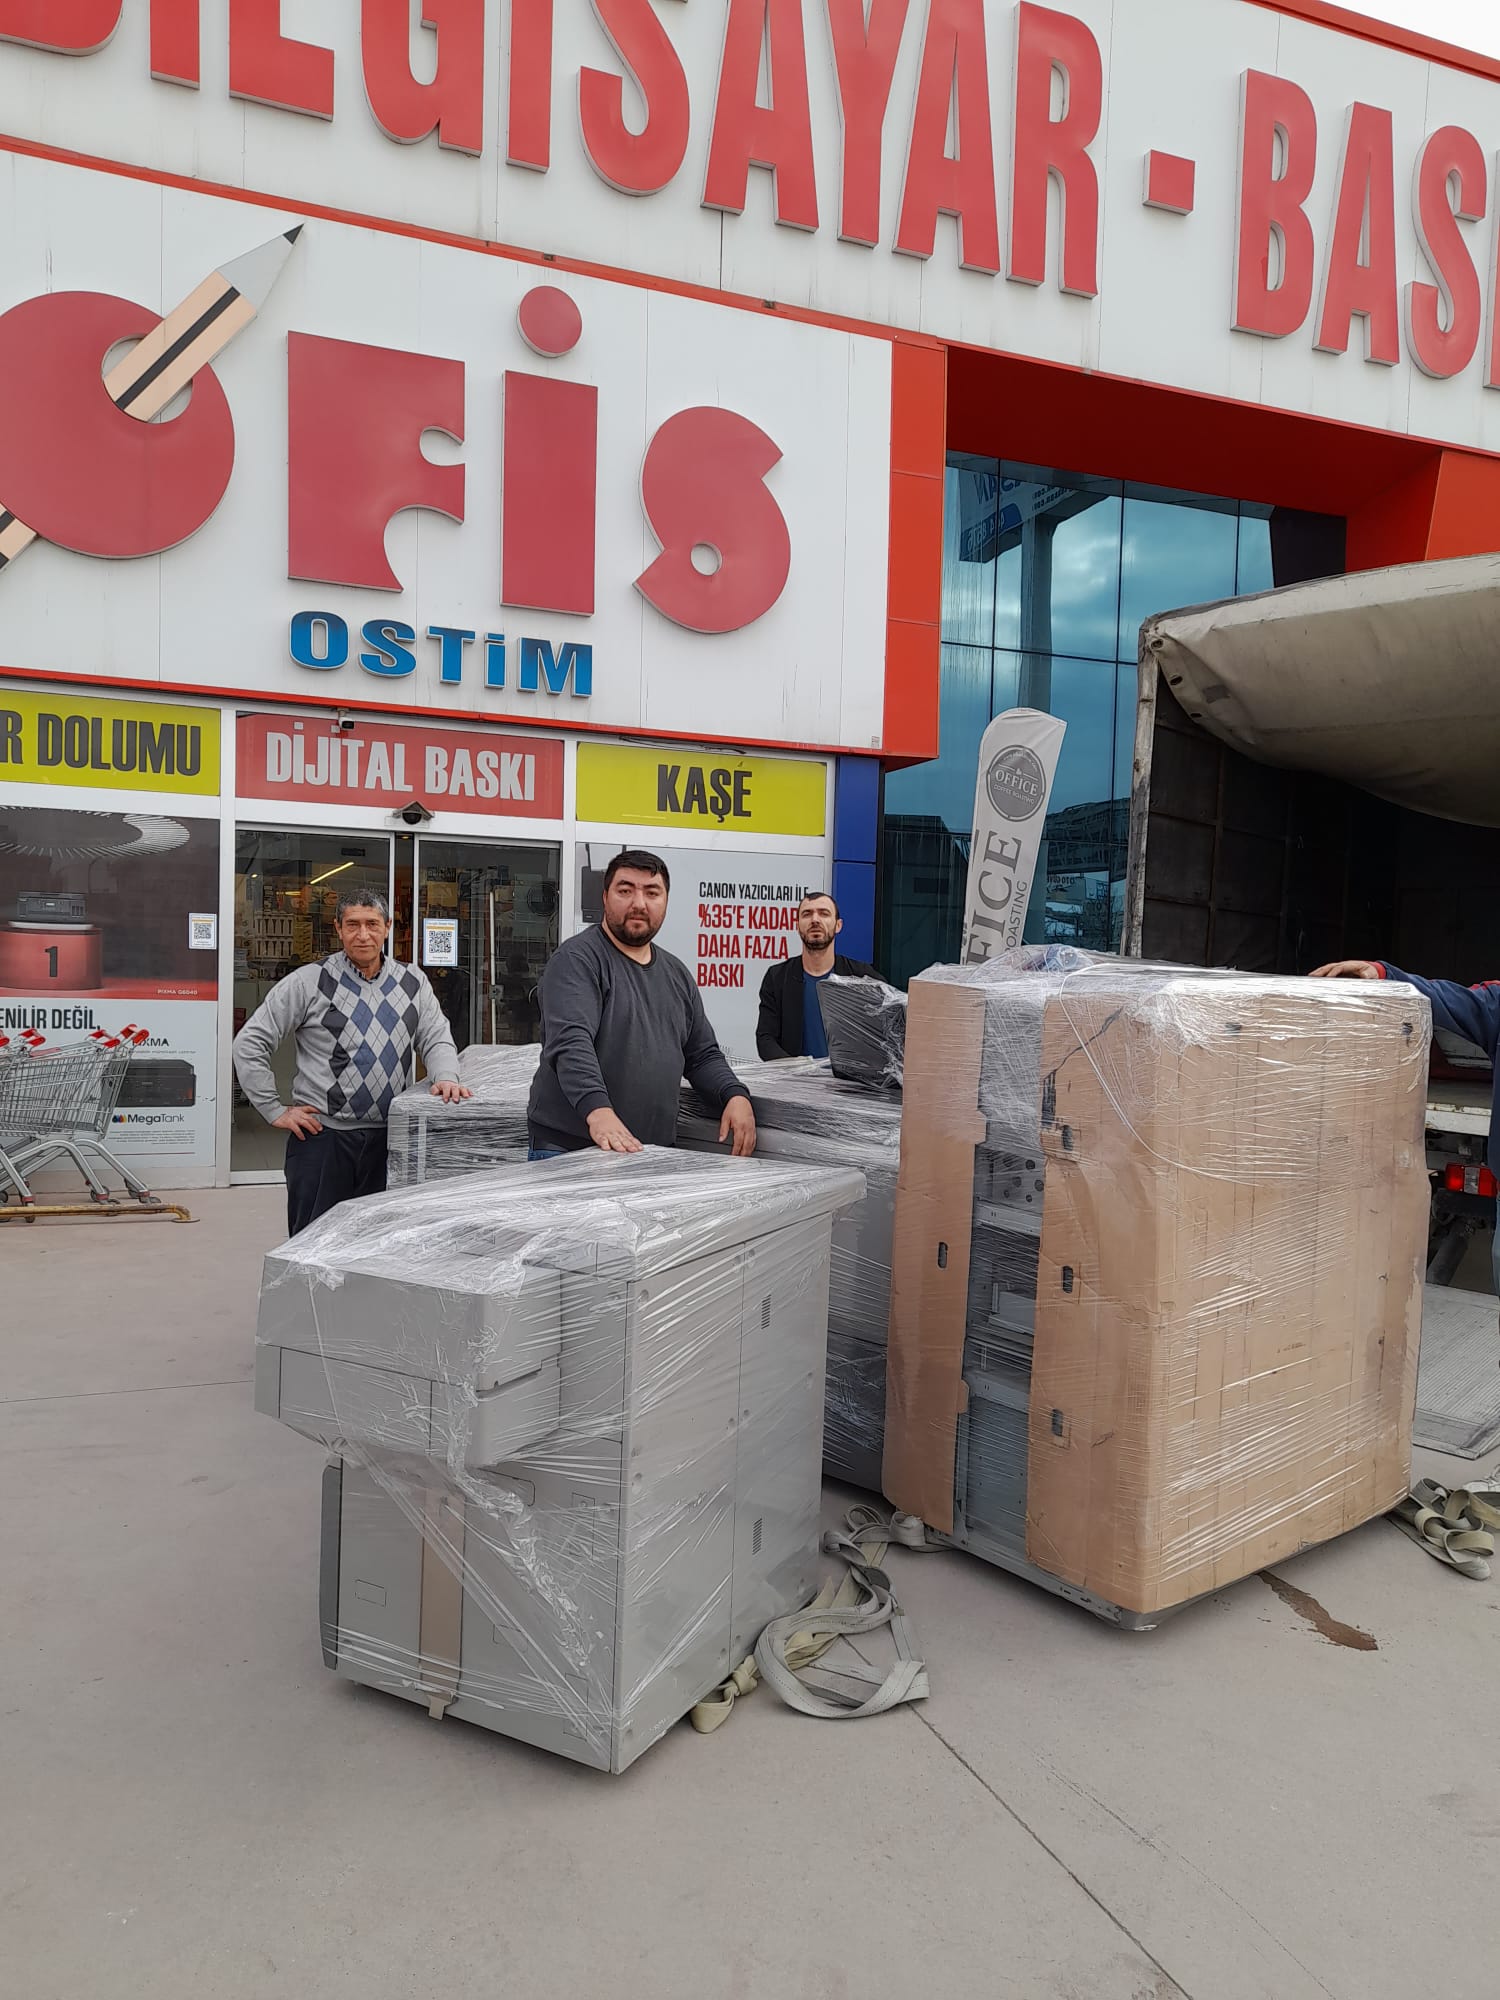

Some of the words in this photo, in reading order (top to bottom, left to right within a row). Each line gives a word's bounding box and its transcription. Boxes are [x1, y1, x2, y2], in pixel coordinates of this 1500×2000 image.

[0, 0, 1102, 299] SAYAR
[1230, 68, 1500, 390] BAS
[38, 713, 201, 776] DOLUMU
[266, 722, 413, 793] DİJİTAL
[425, 746, 535, 801] BASKI
[657, 764, 753, 823] KAŞE
[995, 769, 1039, 797] OFFICE
[699, 881, 736, 899] CANON
[738, 884, 793, 901] YAZICILARI
[698, 903, 745, 929] %35'E
[748, 905, 800, 931] KADAR
[1005, 880, 1028, 951] OASTING
[44, 945, 58, 978] 1
[697, 933, 741, 959] DAHA
[744, 935, 789, 960] FAZLA
[697, 962, 744, 988] BASKI
[127, 1113, 185, 1126] MegaTank
